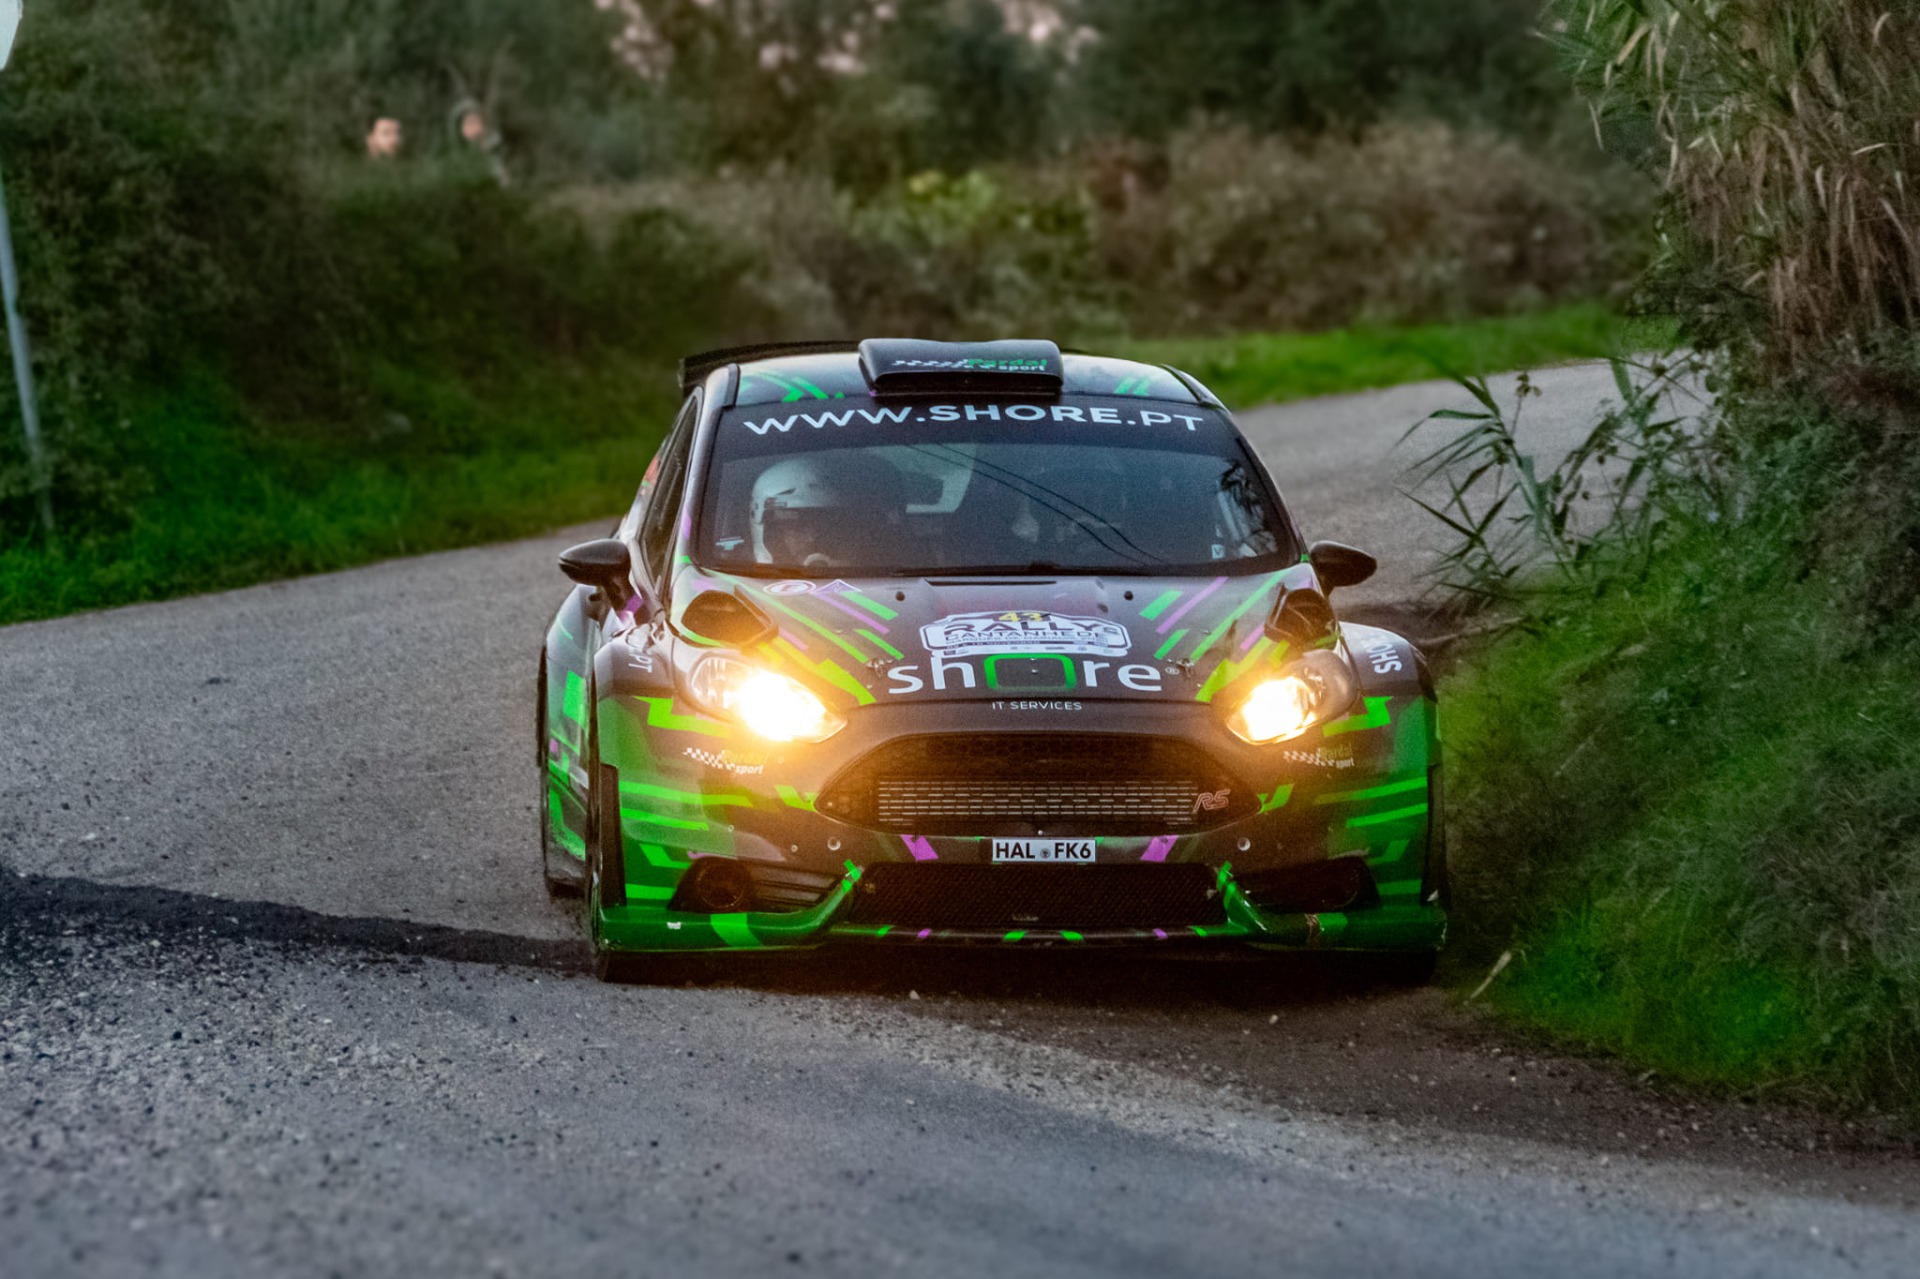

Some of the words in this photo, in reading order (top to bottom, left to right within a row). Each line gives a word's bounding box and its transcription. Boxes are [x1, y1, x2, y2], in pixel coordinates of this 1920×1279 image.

[743, 404, 1203, 435] WWW.SHORE.PT
[944, 621, 1101, 637] RALLY
[992, 700, 1005, 710] IT
[1010, 701, 1082, 710] SERVICES
[735, 764, 764, 775] sport
[1192, 789, 1230, 814] RS
[996, 842, 1035, 859] HAL
[1055, 842, 1091, 859] FK6
